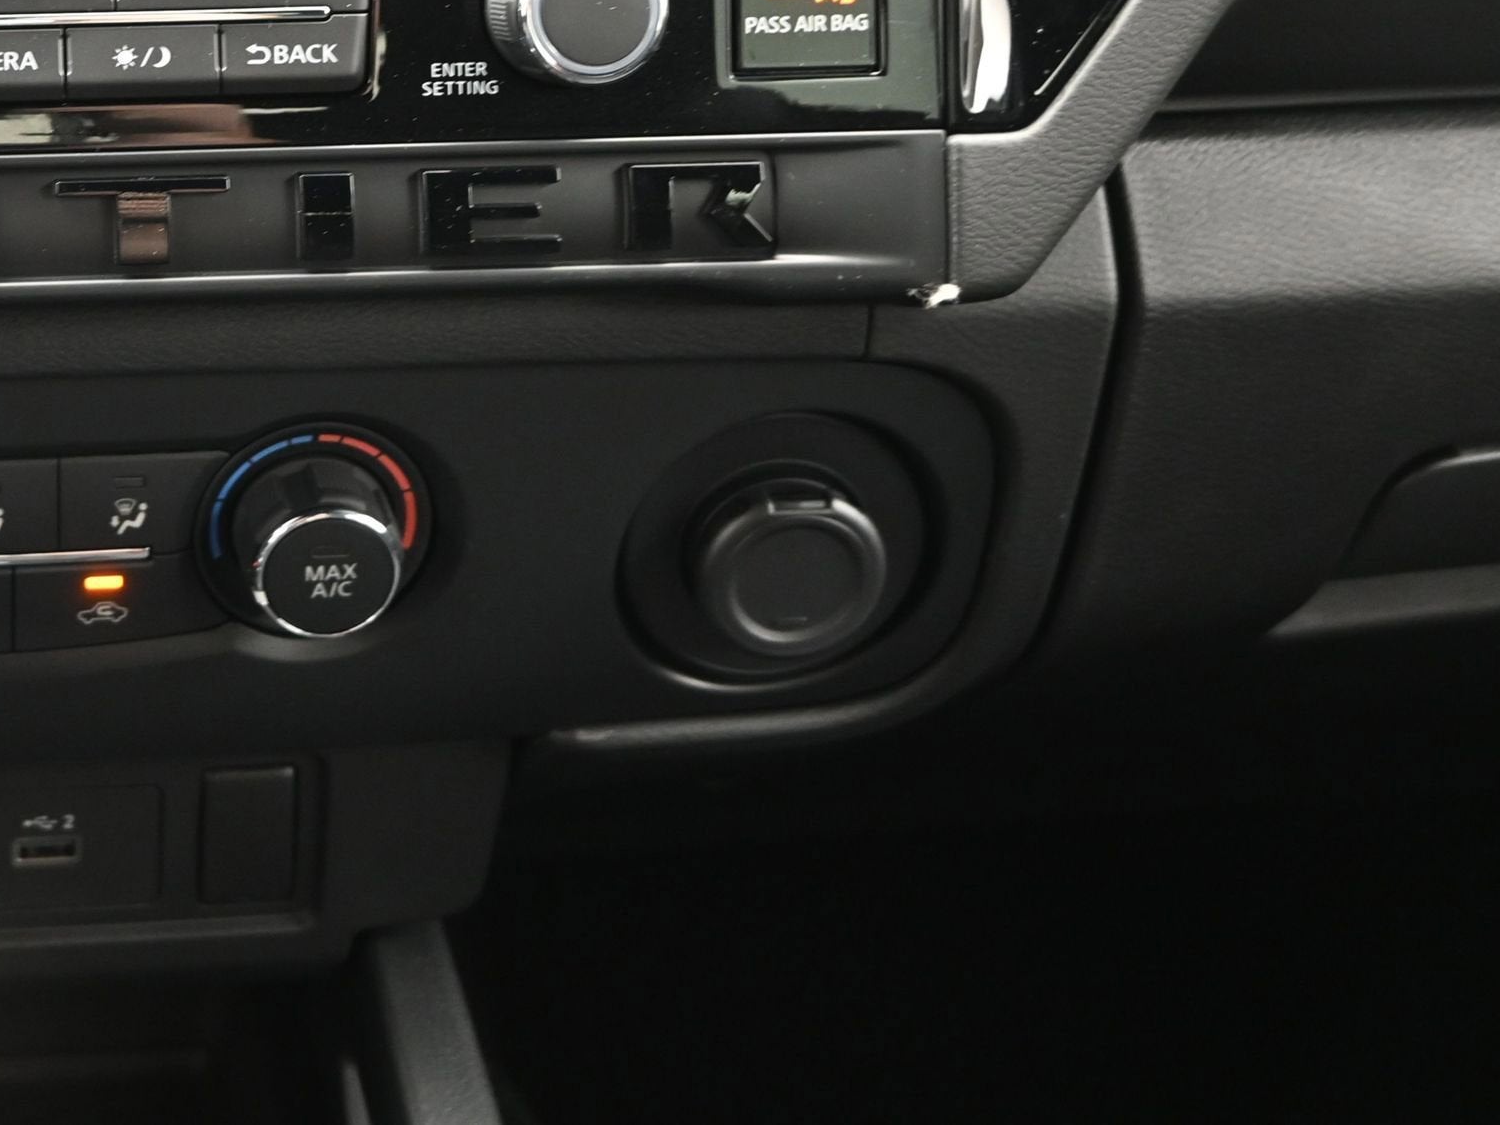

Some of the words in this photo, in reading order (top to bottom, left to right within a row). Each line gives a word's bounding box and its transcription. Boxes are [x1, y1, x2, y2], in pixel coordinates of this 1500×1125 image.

[744, 15, 792, 35] PASS
[793, 14, 828, 33] AIR
[830, 13, 870, 32] BAG
[273, 43, 339, 65] BACK
[430, 62, 489, 79] ENTER
[421, 79, 499, 97] SETTING
[304, 563, 357, 583] MAX
[310, 580, 353, 598] A/C
[62, 813, 76, 830] 2
